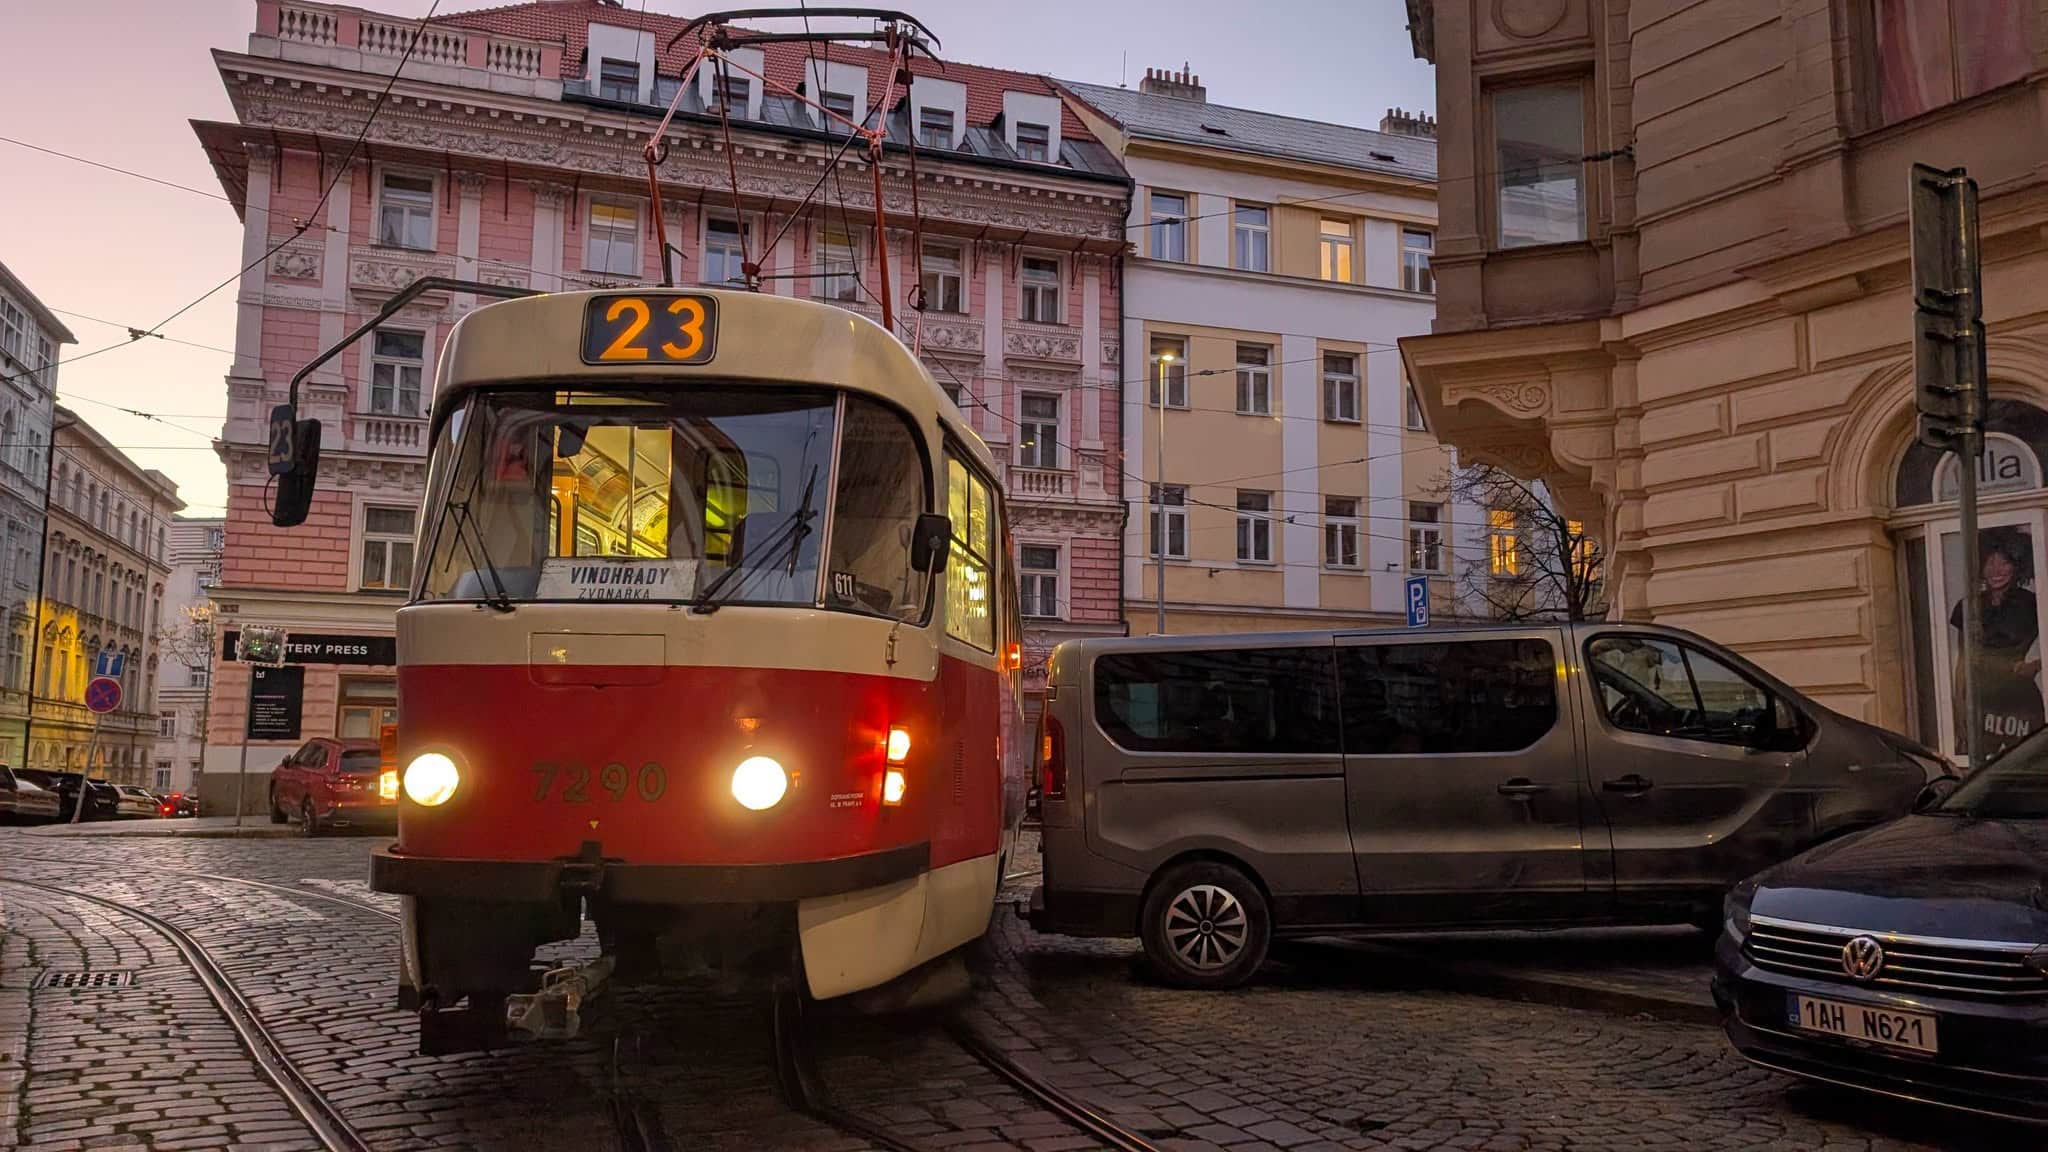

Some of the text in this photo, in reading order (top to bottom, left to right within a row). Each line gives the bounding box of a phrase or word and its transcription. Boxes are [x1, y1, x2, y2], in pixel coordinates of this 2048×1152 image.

[600, 297, 705, 359] 23
[270, 420, 294, 464] 23
[570, 566, 670, 585] VINOHRADY
[835, 572, 853, 597] 611
[1410, 583, 1423, 613] P
[286, 643, 367, 655] TERY PRESS
[1984, 713, 2030, 737] ALON
[530, 761, 667, 804] 7290
[1806, 1000, 1924, 1047] 1AH N621
